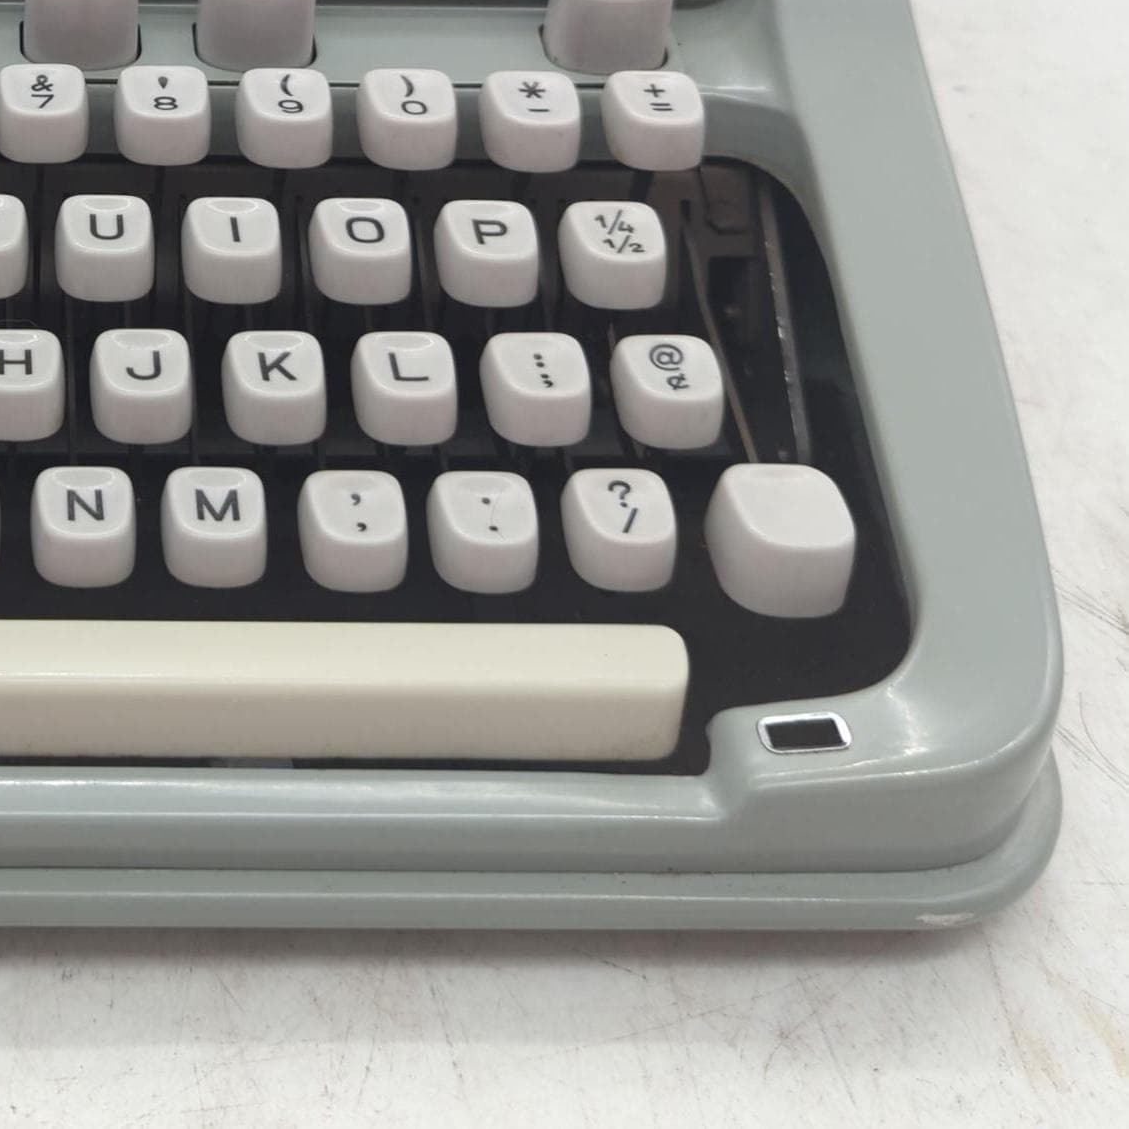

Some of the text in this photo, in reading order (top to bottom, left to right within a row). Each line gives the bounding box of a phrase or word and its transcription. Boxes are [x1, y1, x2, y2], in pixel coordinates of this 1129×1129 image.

[30, 74, 54, 92] &
[280, 74, 293, 97] (
[401, 75, 415, 98] )
[643, 83, 665, 98] +
[31, 93, 55, 109] 7
[153, 96, 179, 111] 8
[277, 99, 304, 114] 9
[400, 100, 428, 116] 0
[89, 213, 125, 241] U
[229, 216, 241, 243] I
[345, 216, 385, 244] O
[472, 219, 508, 245] P
[125, 351, 162, 381] J
[258, 351, 297, 382] K
[388, 352, 430, 382] L
[649, 343, 684, 372] @
[66, 489, 105, 522] N
[195, 489, 241, 522] M
[607, 480, 632, 508] ?
[621, 507, 638, 534] /
